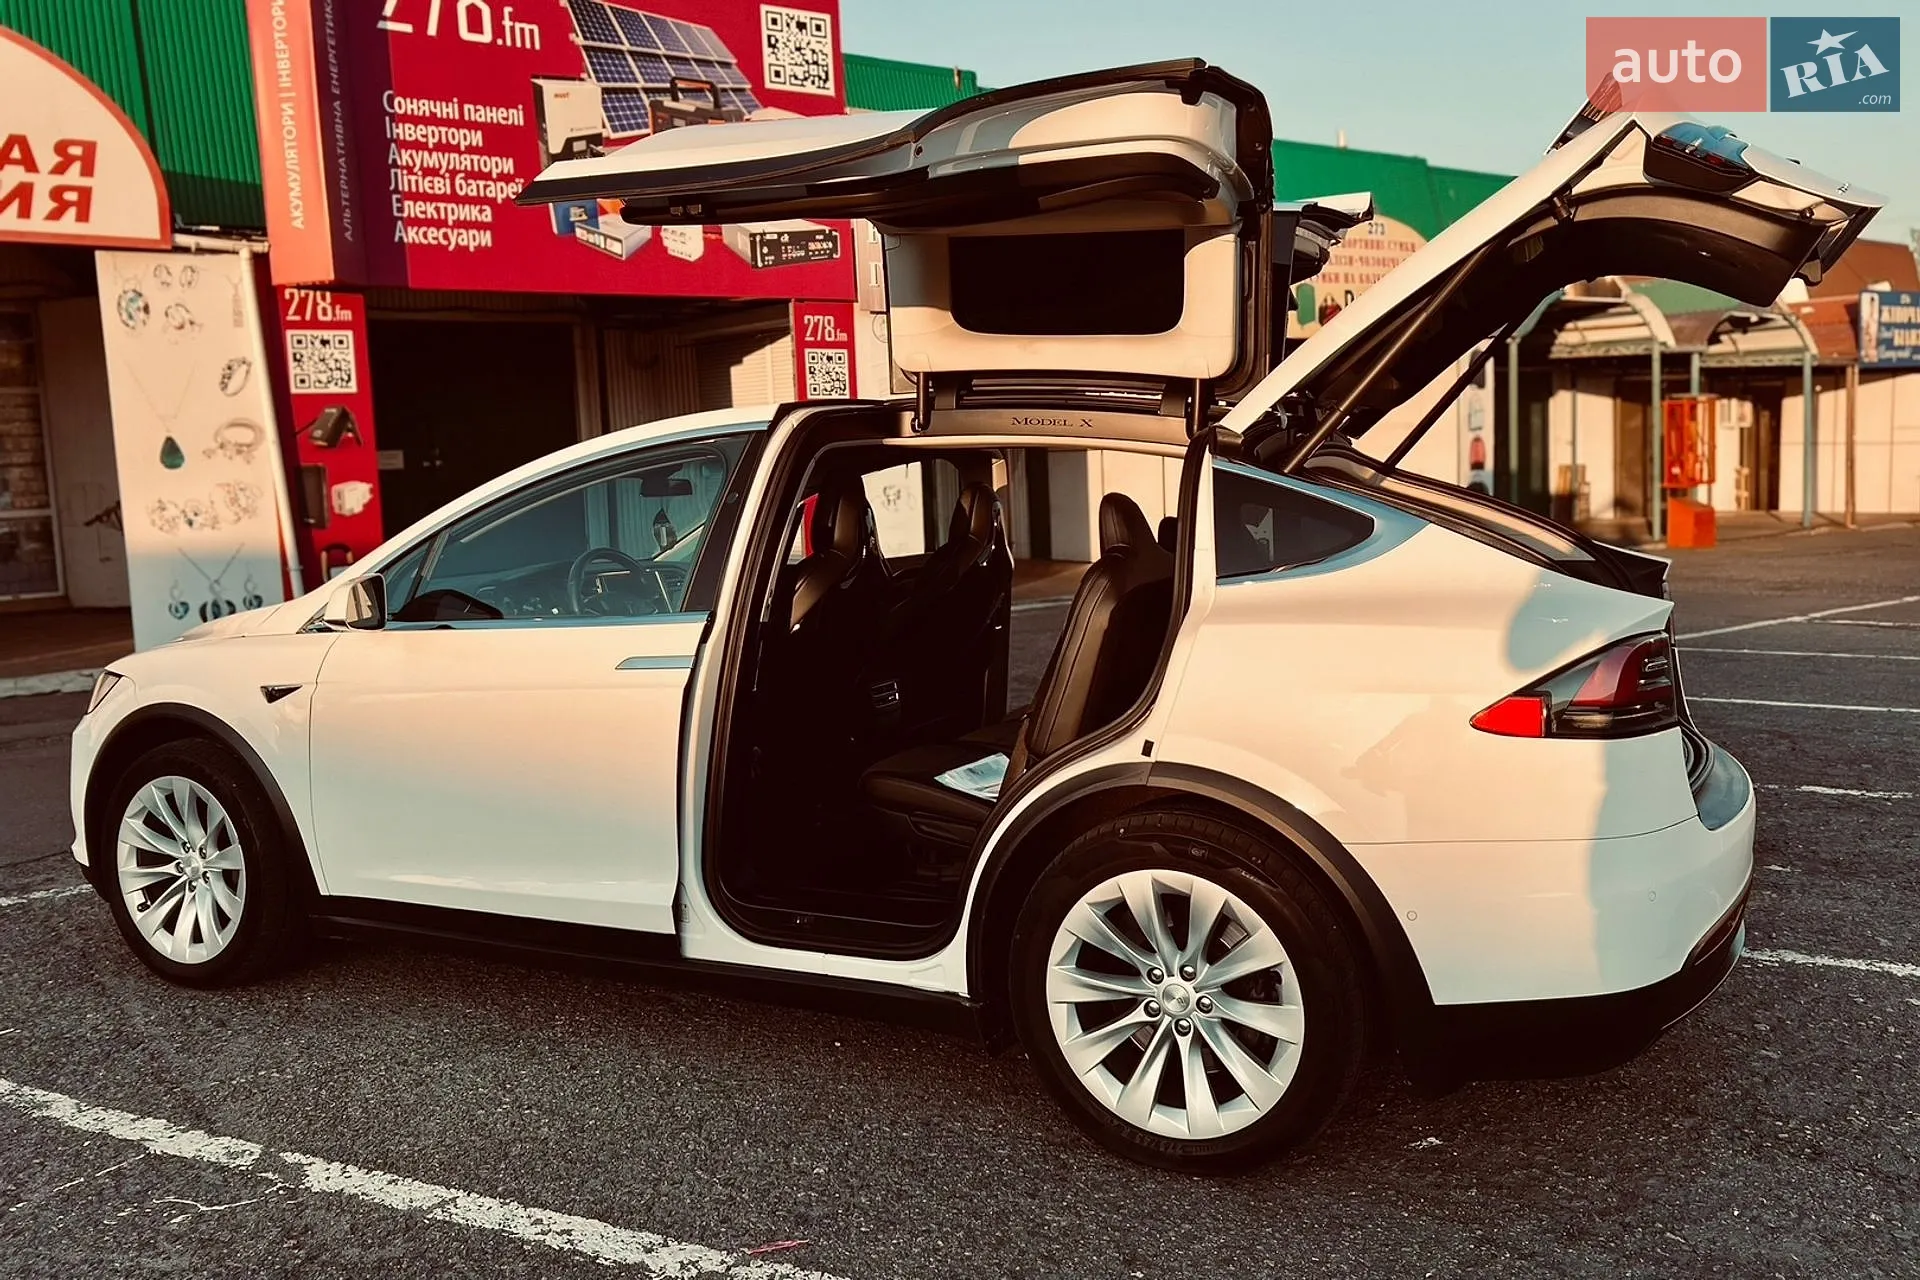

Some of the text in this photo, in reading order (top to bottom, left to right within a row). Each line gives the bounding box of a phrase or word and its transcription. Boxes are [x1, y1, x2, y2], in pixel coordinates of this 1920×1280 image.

[382, 90, 524, 126] Сонячні панелі
[385, 116, 484, 151] Інвертори
[281, 102, 305, 230] АКУМУЛЯТОРИ
[332, 101, 353, 241] АЛЬТЕРНАТИВНА
[388, 142, 515, 179] Акумулятори
[389, 168, 525, 204] Літієві батареї
[392, 194, 493, 226] Електрика
[394, 220, 493, 252] Аксесуари
[284, 288, 353, 322] 278.fm
[804, 315, 848, 342] 278.fm
[1012, 417, 1094, 428] MODEL X
